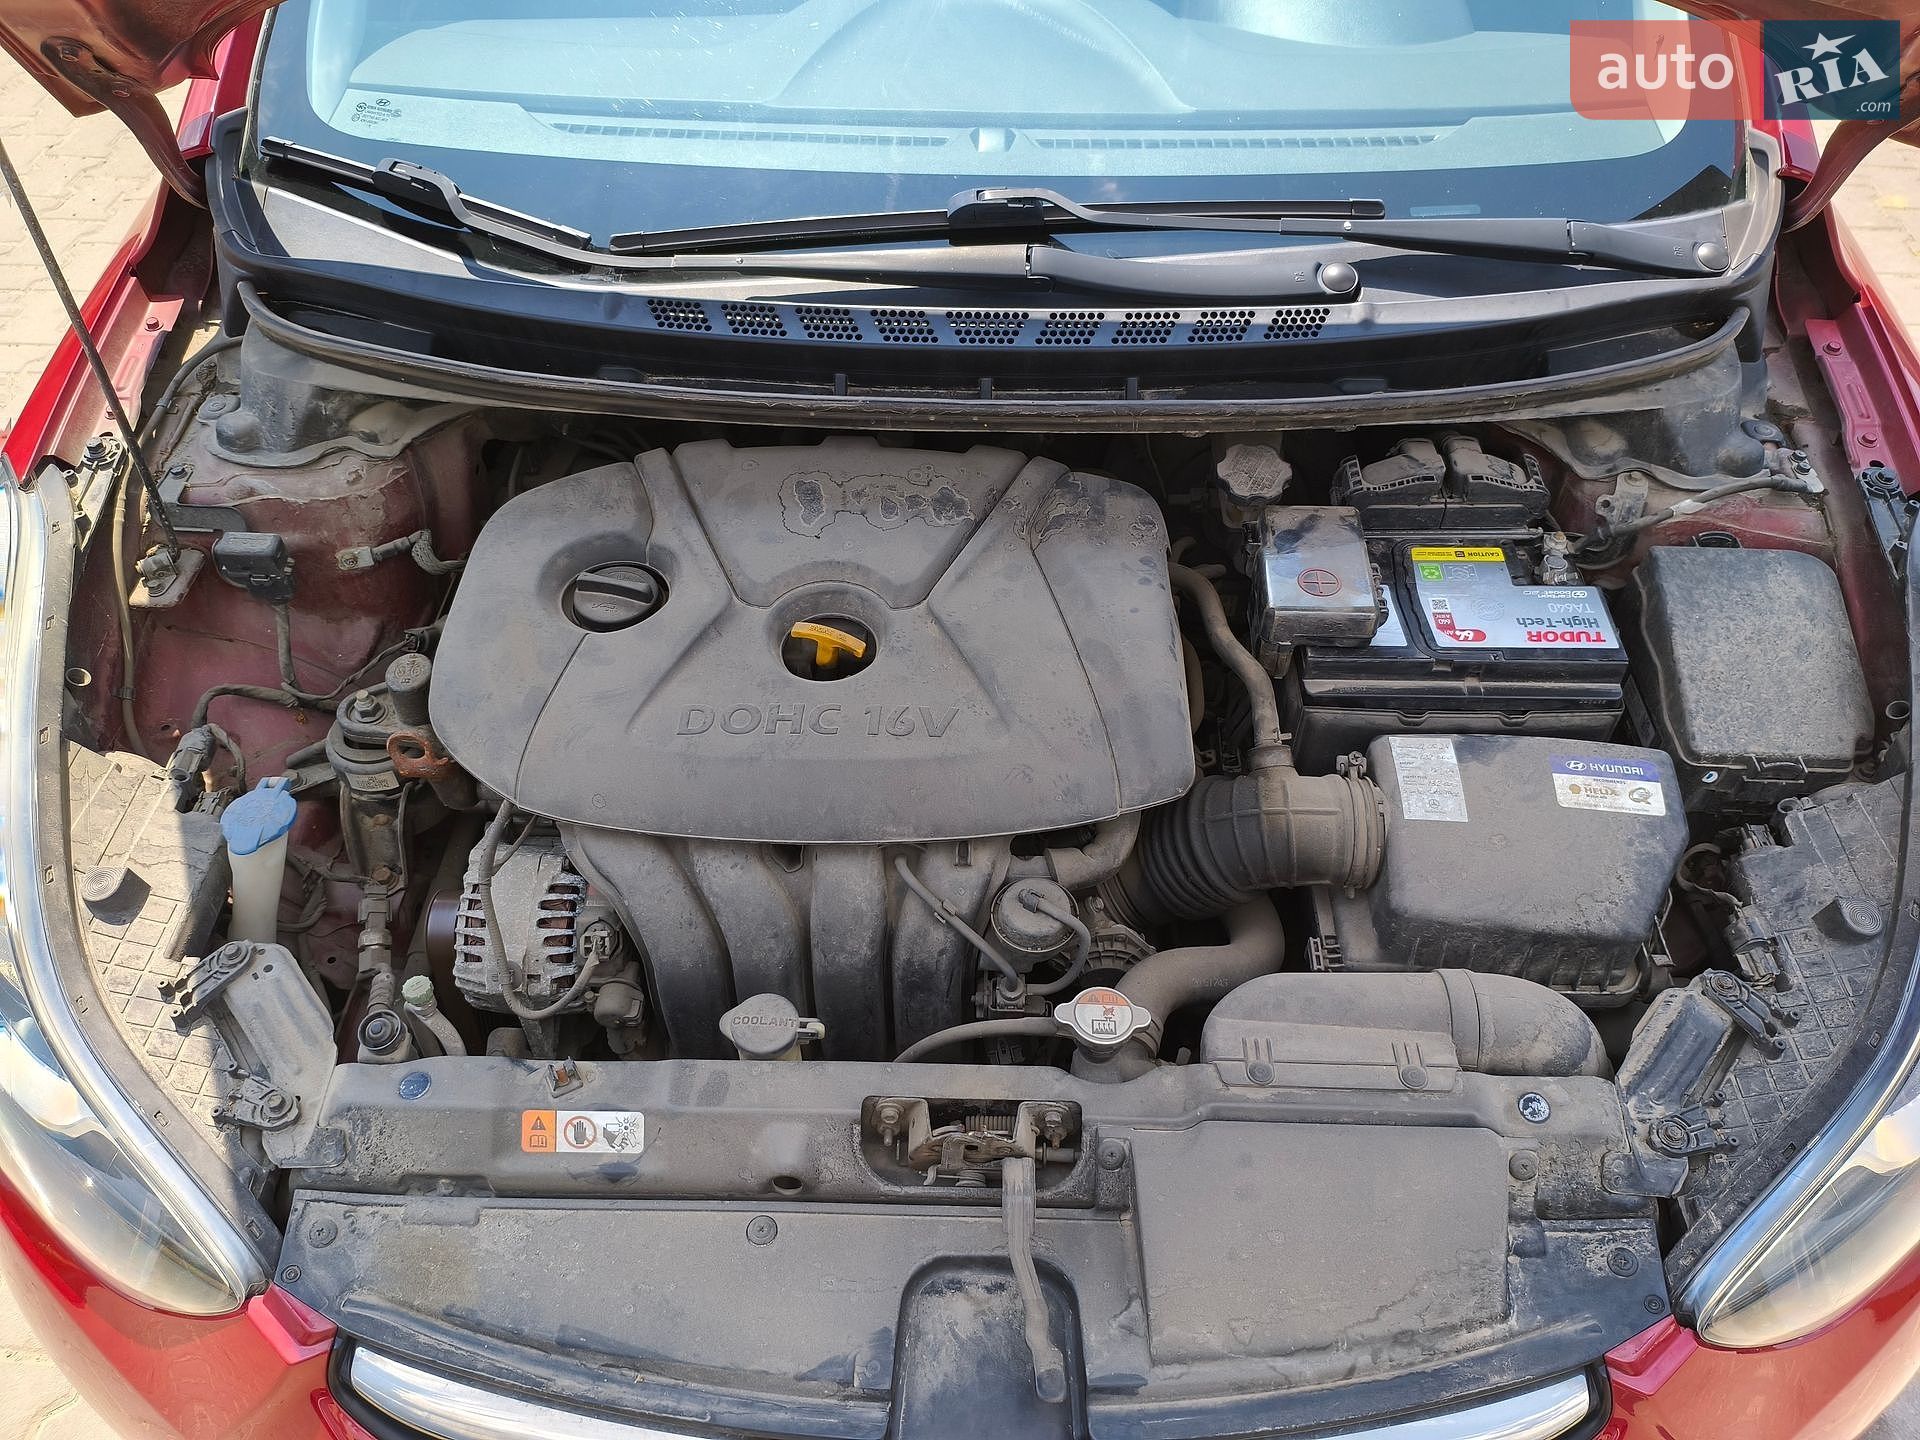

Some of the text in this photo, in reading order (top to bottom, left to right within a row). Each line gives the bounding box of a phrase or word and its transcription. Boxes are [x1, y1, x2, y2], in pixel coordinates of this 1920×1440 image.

[1548, 603, 1594, 613] TA640
[1516, 616, 1600, 628] High-Tech
[1455, 630, 1474, 641] 64
[1527, 630, 1607, 642] TUDOR
[676, 704, 960, 738] DOHC 16V
[1590, 763, 1644, 775] HYUNDAI
[732, 1016, 797, 1028] COOLANT
